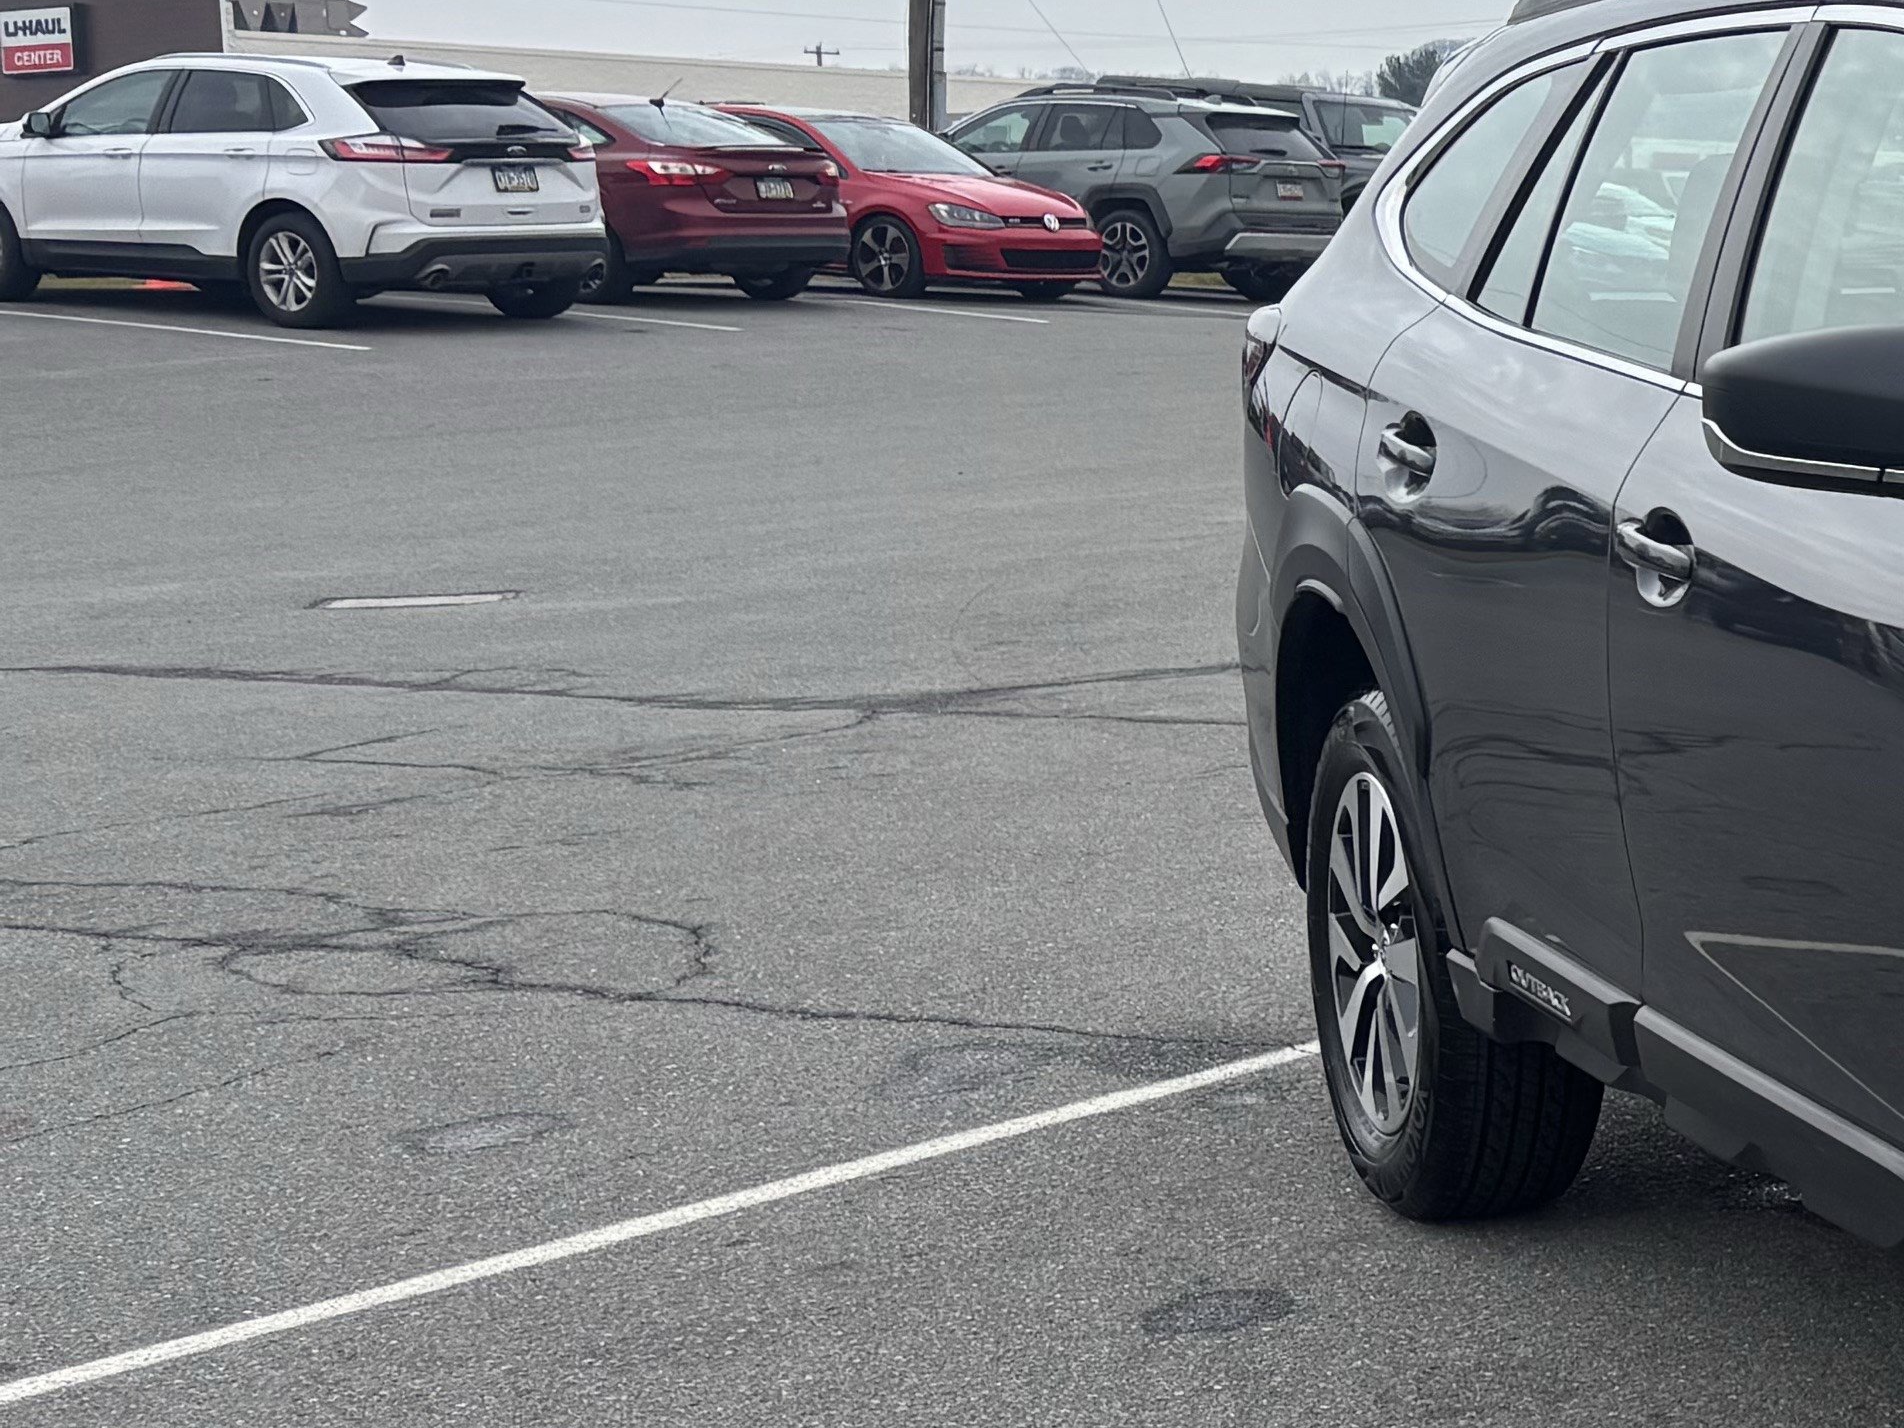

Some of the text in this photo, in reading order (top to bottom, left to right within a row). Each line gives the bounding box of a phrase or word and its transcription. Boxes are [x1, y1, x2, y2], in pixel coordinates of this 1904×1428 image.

[3, 17, 67, 37] U-HAUL
[14, 49, 63, 66] CENTER
[1510, 963, 1573, 1017] OUTBACK
